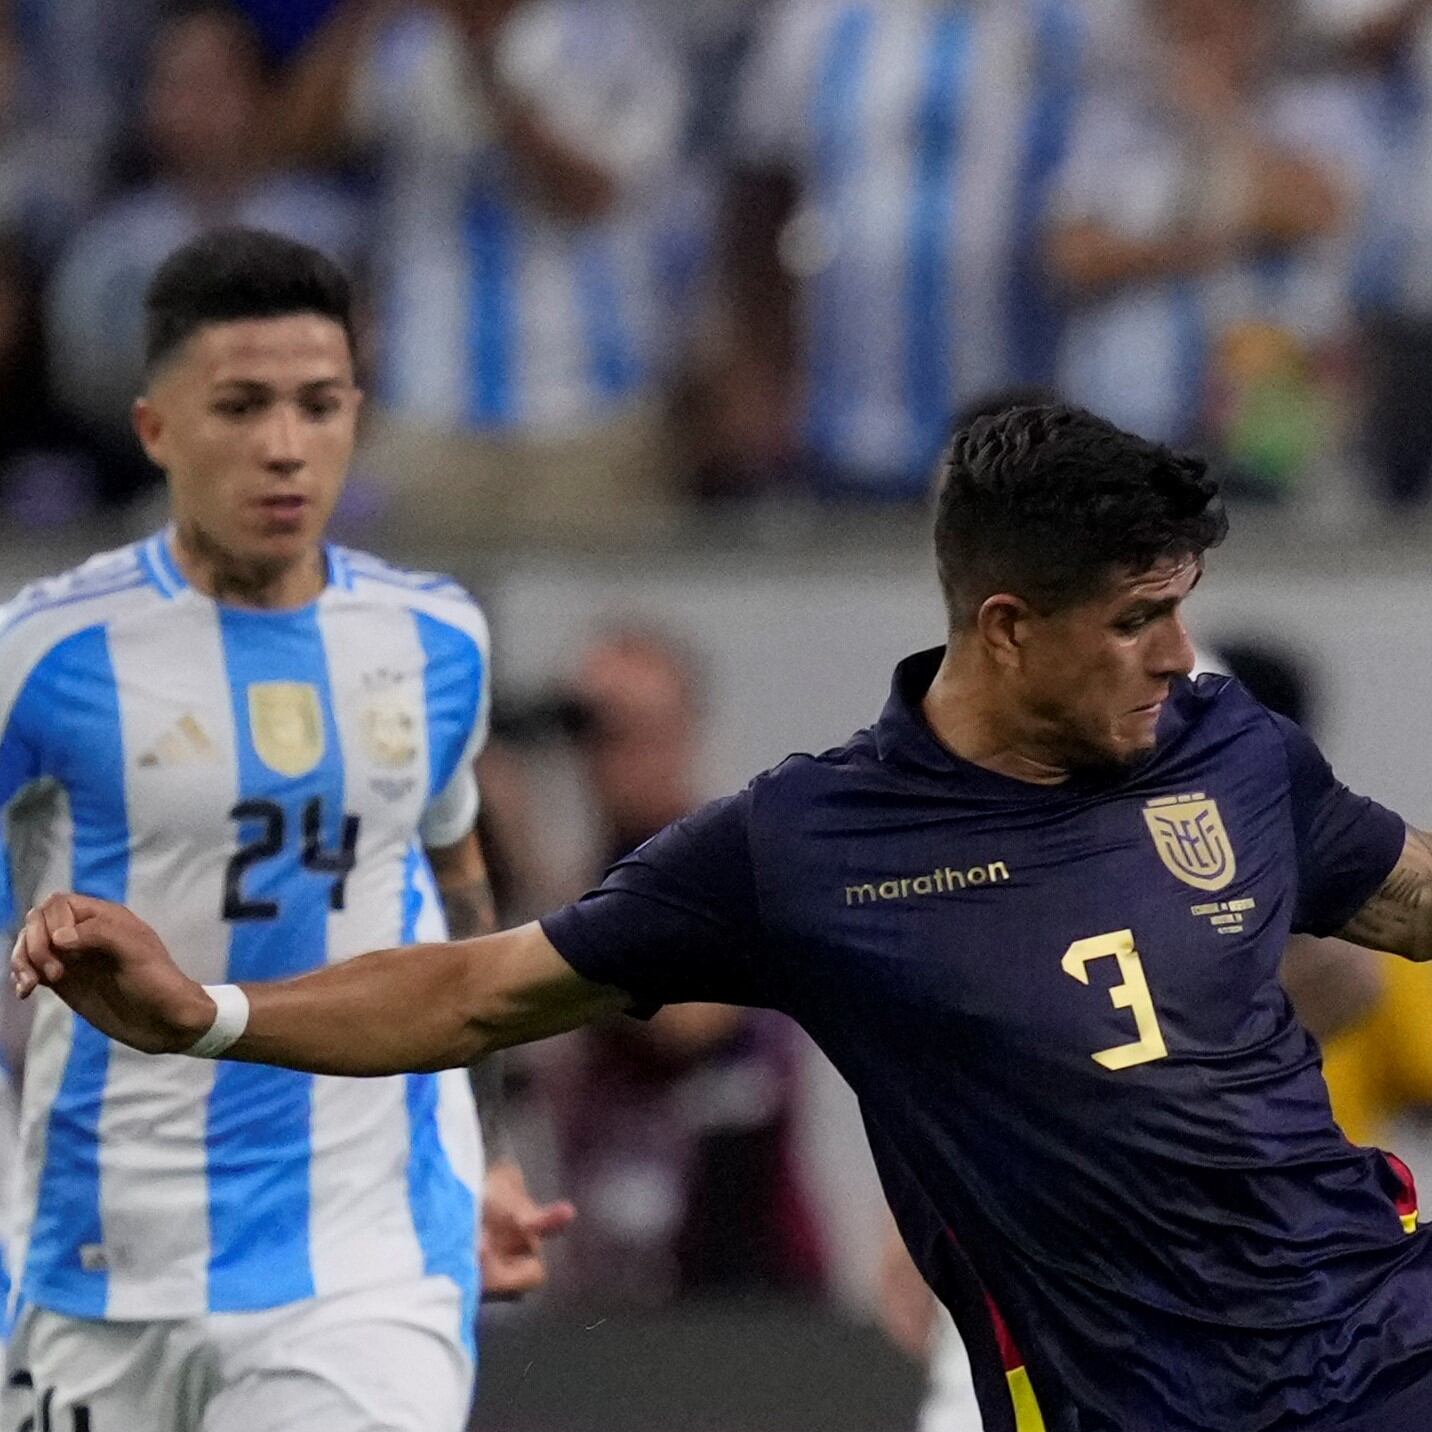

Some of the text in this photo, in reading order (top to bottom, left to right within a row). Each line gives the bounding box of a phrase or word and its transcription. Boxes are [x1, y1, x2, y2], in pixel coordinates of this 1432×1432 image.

[222, 797, 361, 921] 24
[845, 860, 1010, 906] marathon
[1061, 928, 1169, 1071] 3
